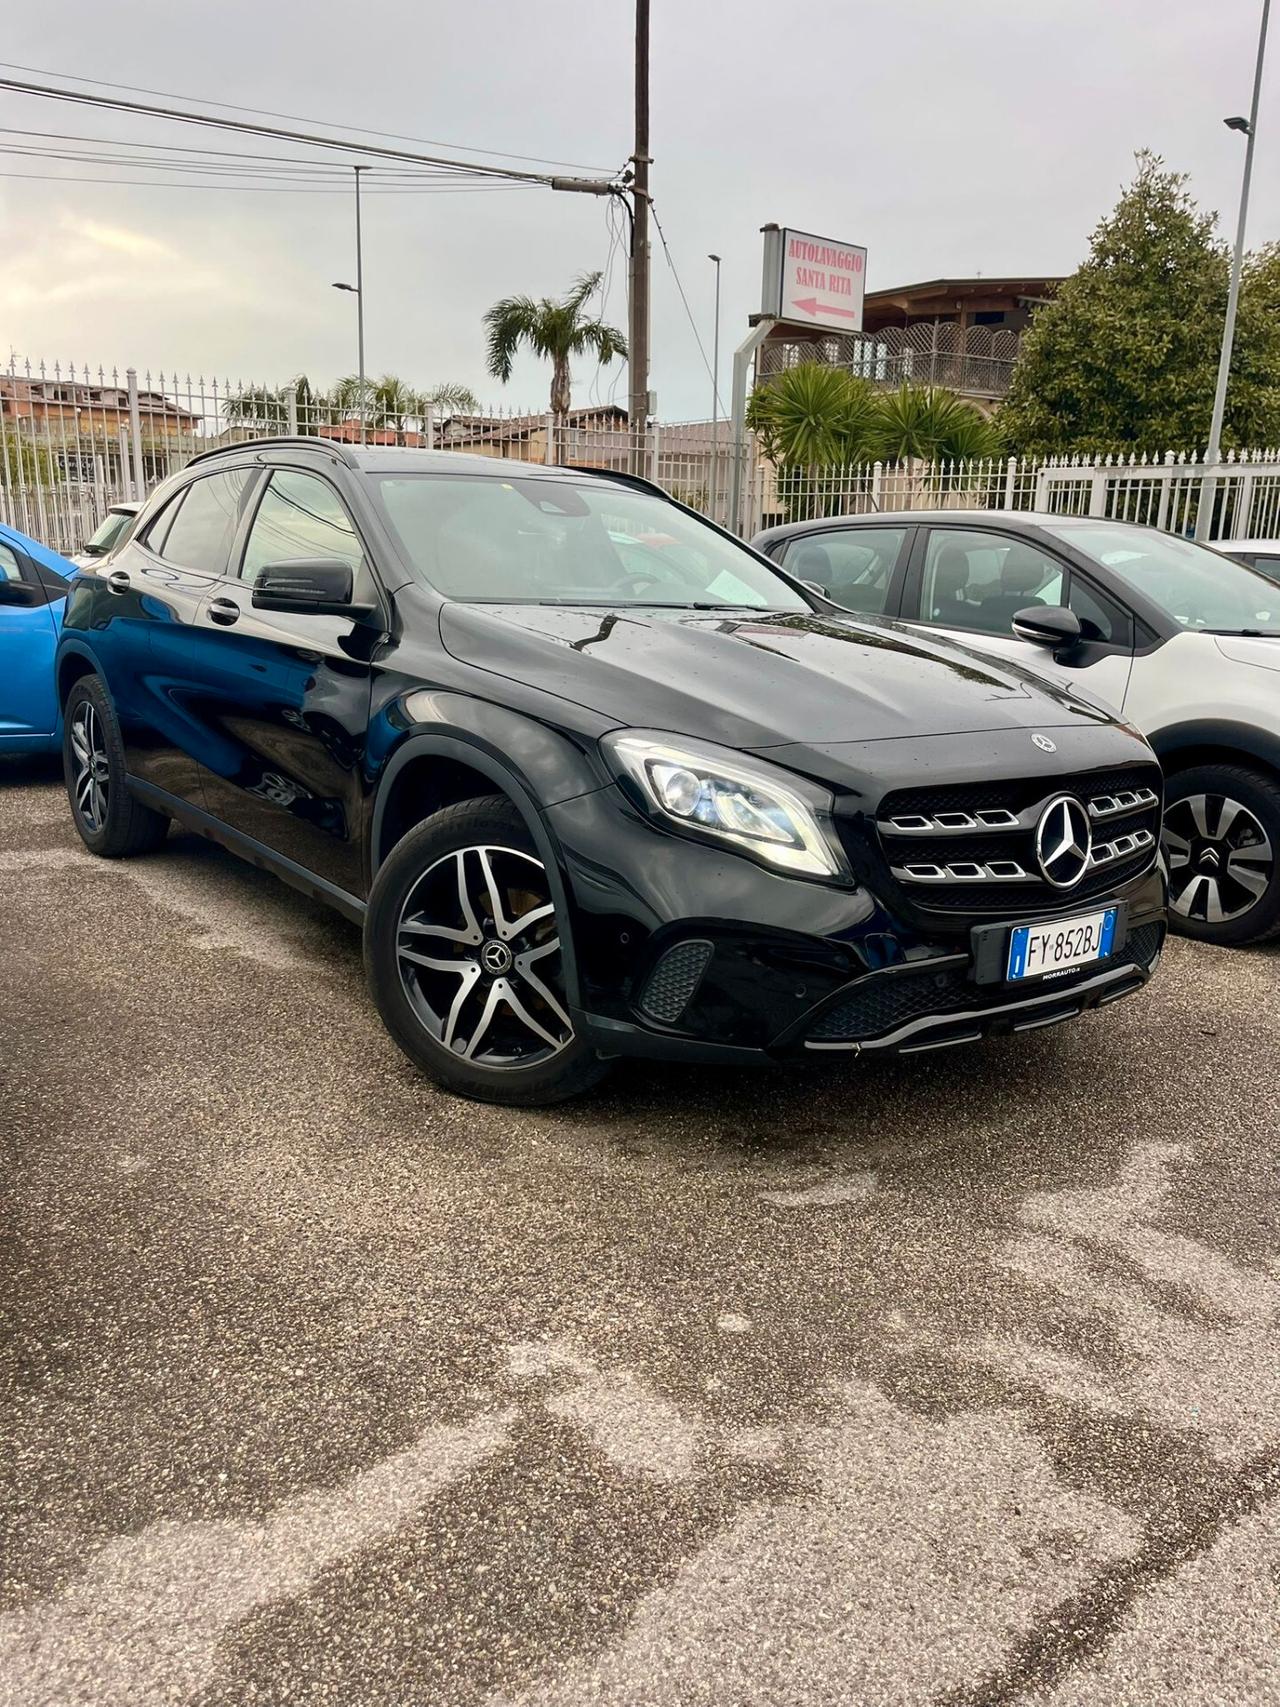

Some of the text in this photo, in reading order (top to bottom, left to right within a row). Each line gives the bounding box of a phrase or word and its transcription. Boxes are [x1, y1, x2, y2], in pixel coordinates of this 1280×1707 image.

[788, 239, 863, 273] AUTOLAVAGGIO
[796, 266, 852, 296] SANTA RITA
